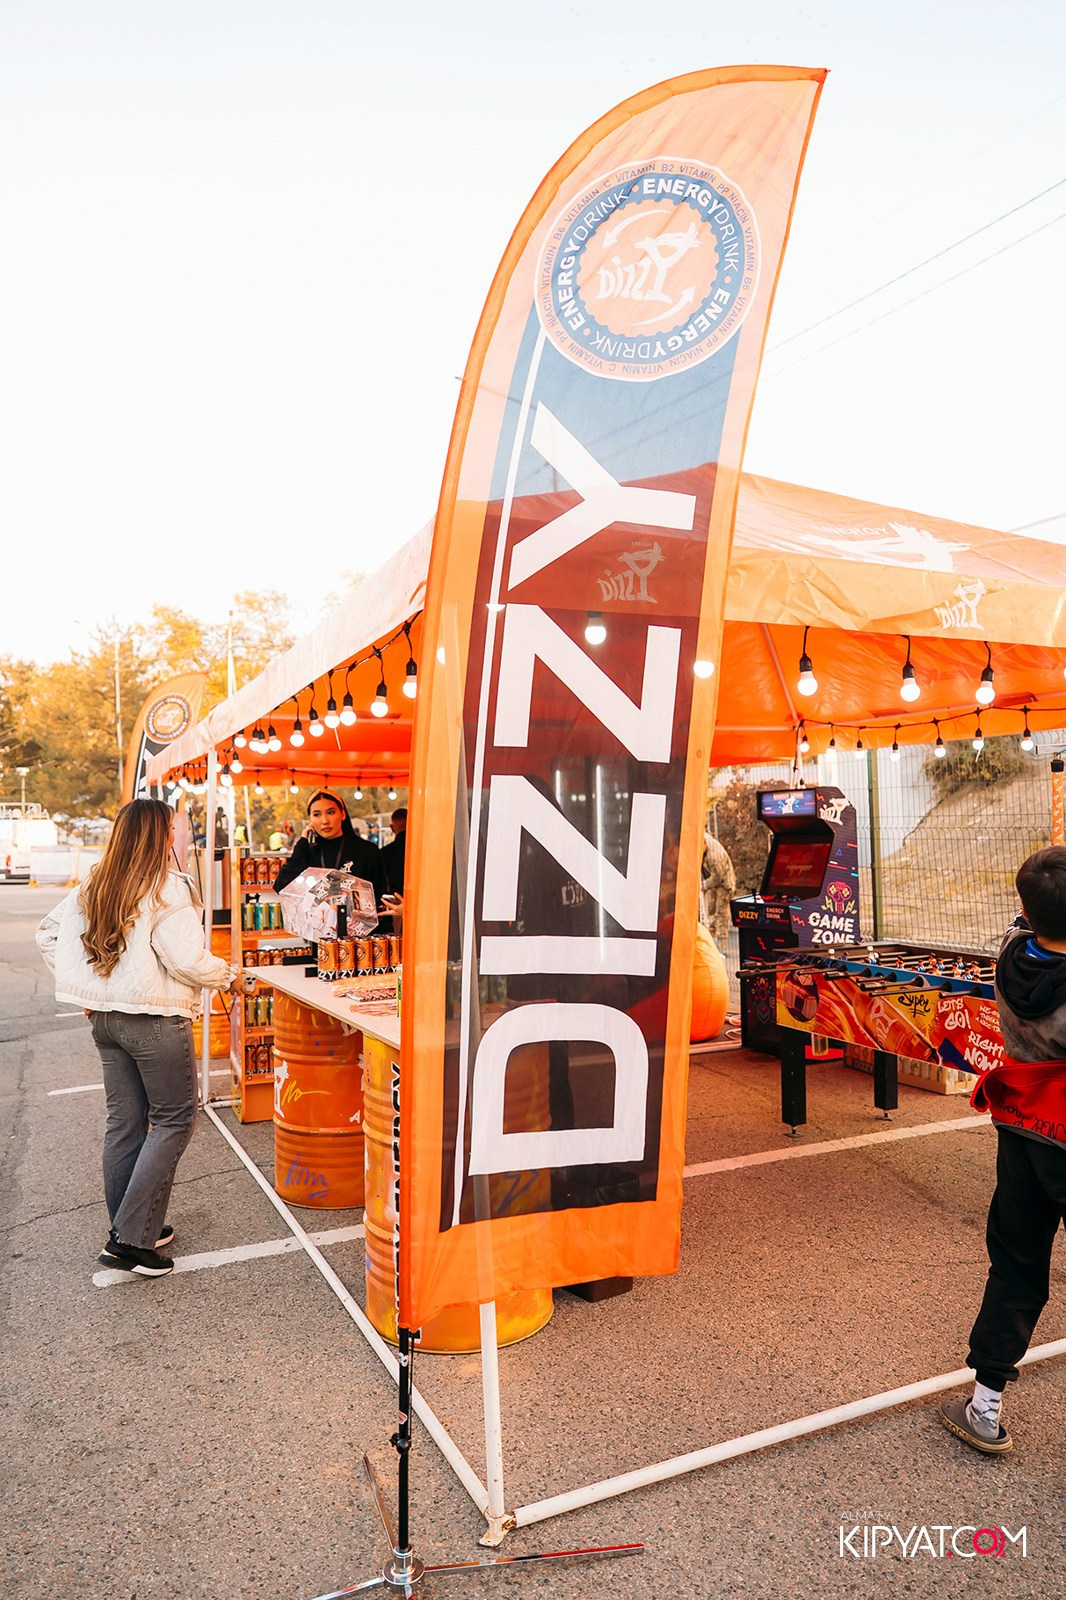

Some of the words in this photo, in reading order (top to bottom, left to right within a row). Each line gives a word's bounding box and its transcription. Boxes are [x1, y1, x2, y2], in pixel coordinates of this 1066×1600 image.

[615, 163, 656, 183] VITAMIN
[661, 163, 675, 173] B2
[679, 165, 716, 183] VITAMIN
[603, 179, 611, 189] C
[717, 183, 730, 194] PP
[564, 188, 599, 222] VITAMIN
[730, 194, 748, 225] NIACIN
[554, 227, 565, 240] B6
[745, 227, 756, 272] VITAMIN
[541, 246, 557, 288] VITAMIN
[543, 293, 559, 328] NIACIN
[719, 296, 746, 335] VITAMIN
[568, 343, 603, 369] VITAMIN
[669, 345, 705, 368] NIACIN
[621, 364, 664, 374] VITAMIN
[468, 400, 697, 1176] DIZZY
[738, 910, 759, 920] DIZZY
[808, 911, 855, 933] GAME
[811, 928, 856, 945] ZONE
[968, 1031, 1005, 1058] RIGHT
